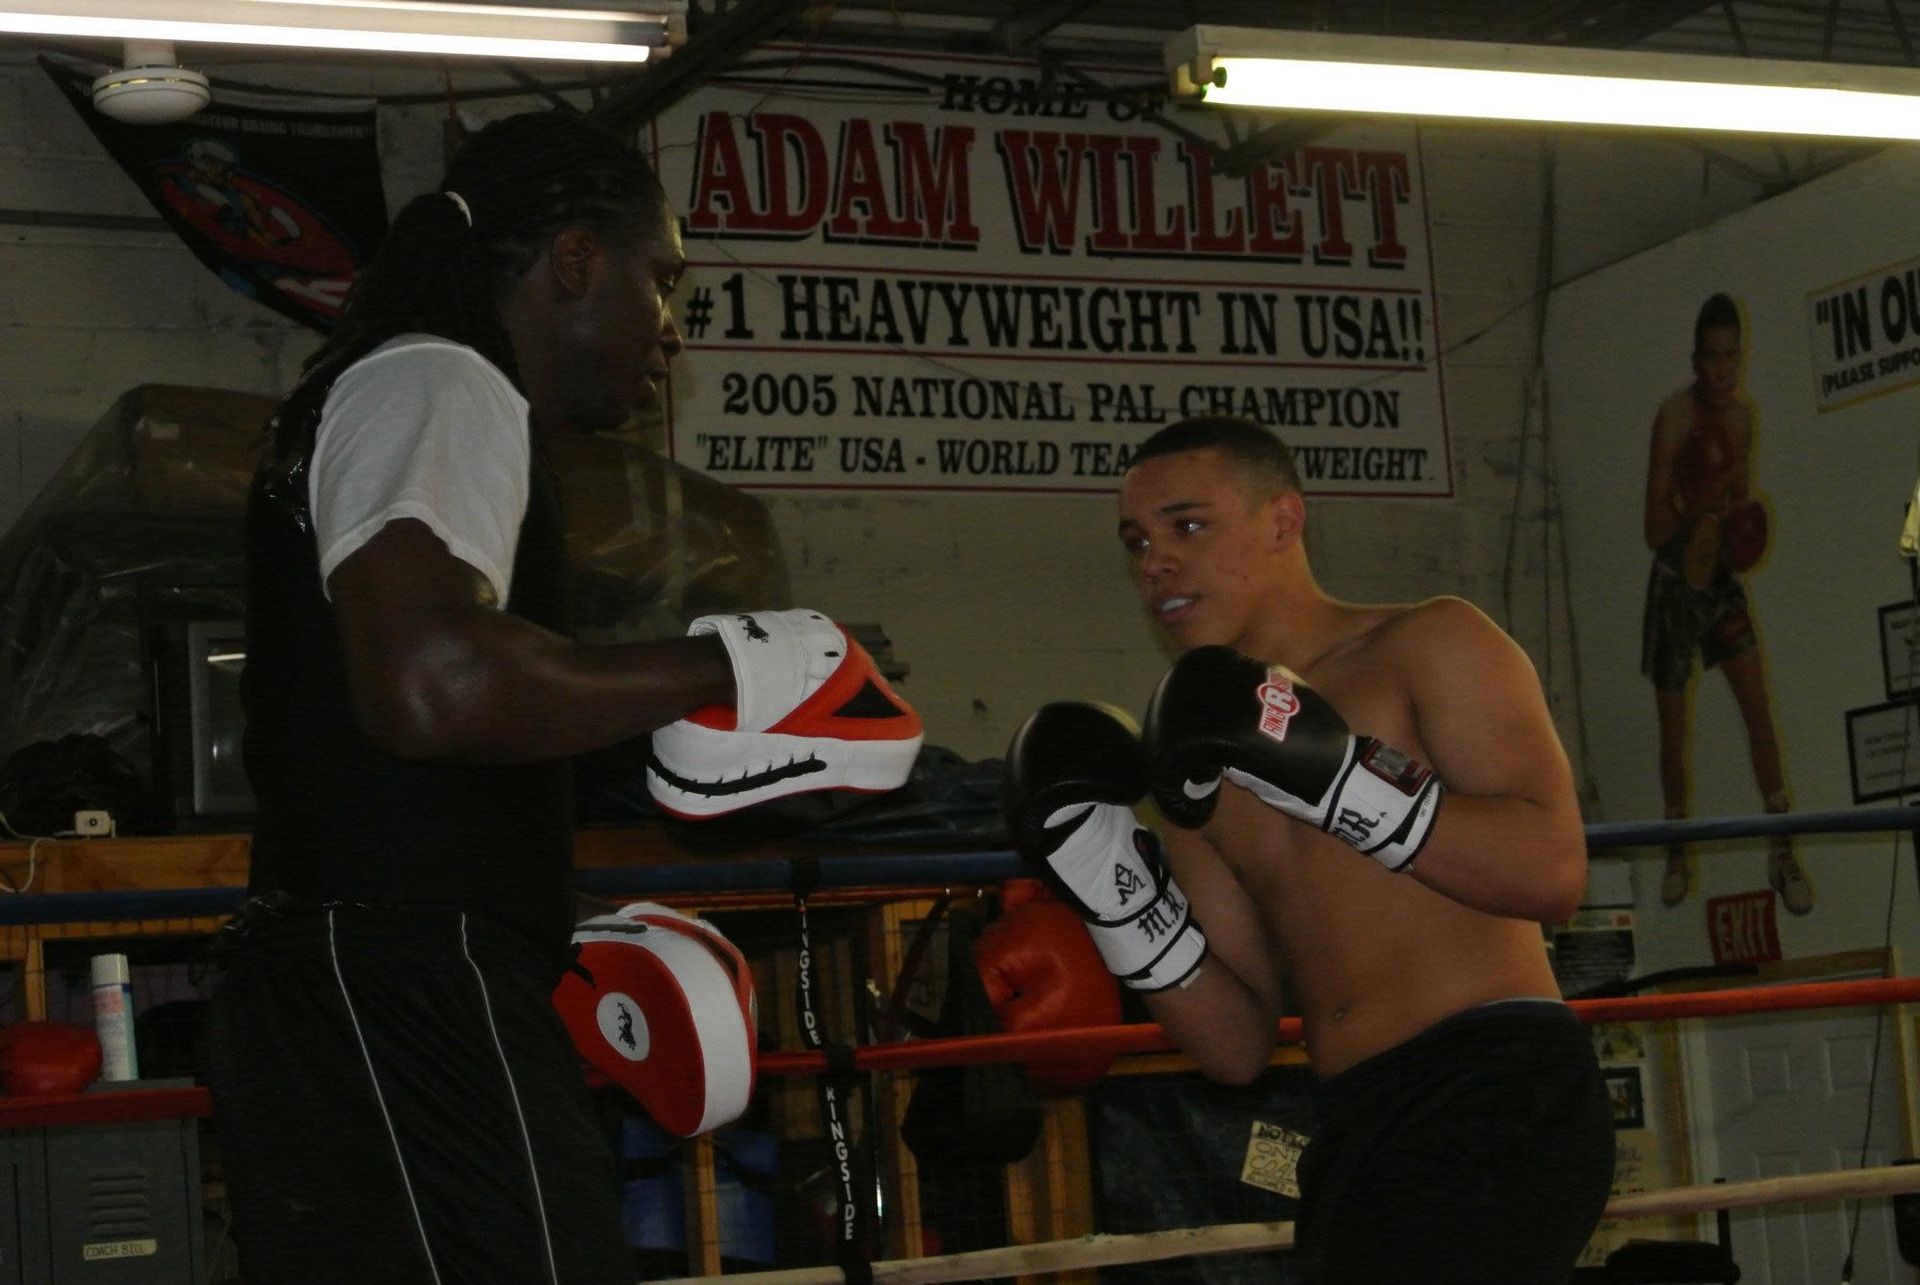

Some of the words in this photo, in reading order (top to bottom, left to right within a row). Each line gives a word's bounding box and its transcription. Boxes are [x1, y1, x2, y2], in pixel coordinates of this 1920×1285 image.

[940, 74, 1088, 118] HOME
[686, 112, 979, 248] ADAM
[998, 132, 1411, 266] WILLETT
[685, 273, 754, 339] #1
[777, 275, 1200, 353] HEAVYWEIGHT
[1217, 292, 1277, 355] IN
[1300, 296, 1425, 362] USA!!
[722, 372, 837, 416] 2005
[852, 376, 1075, 422] NATIONAL
[1088, 383, 1165, 424] PAL
[1179, 385, 1400, 428] CHAMPION
[697, 434, 828, 471] "ELITE"
[839, 437, 906, 473] USA
[937, 439, 1060, 475] WORLD
[1071, 442, 1140, 476] TEA
[1290, 446, 1428, 481] WEIGHT
[1715, 899, 1768, 961] EXIT
